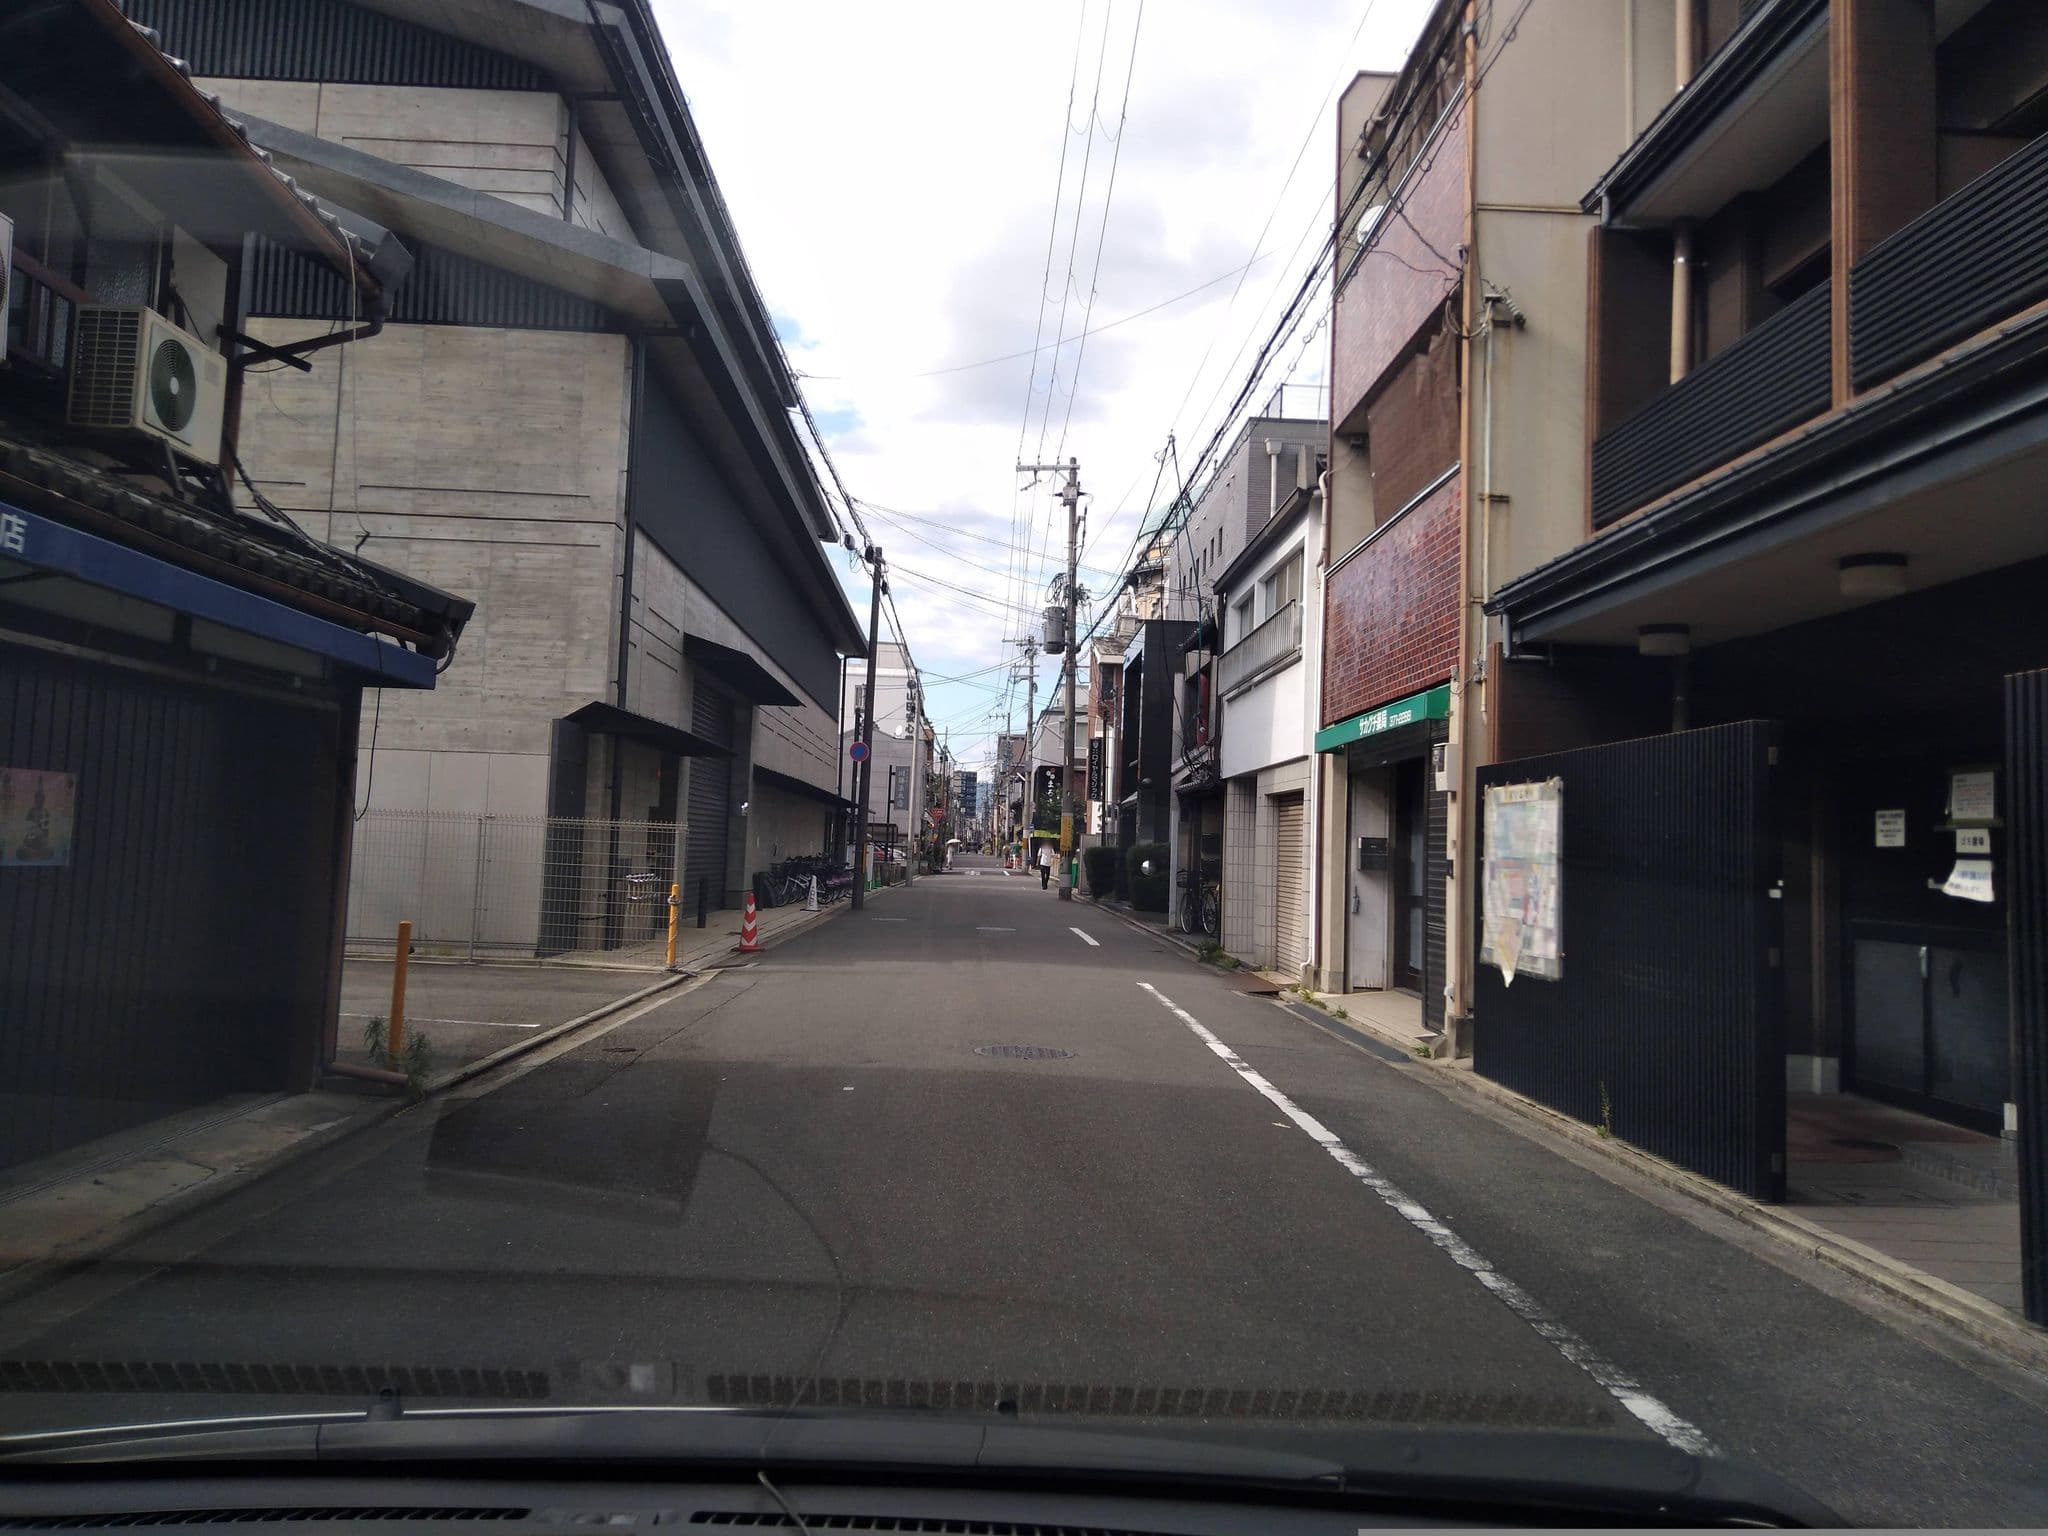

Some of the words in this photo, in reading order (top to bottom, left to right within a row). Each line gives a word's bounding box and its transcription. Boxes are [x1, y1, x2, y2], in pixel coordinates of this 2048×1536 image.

[0, 513, 27, 553] 店
[1359, 710, 1388, 736] サカグチ薬局
